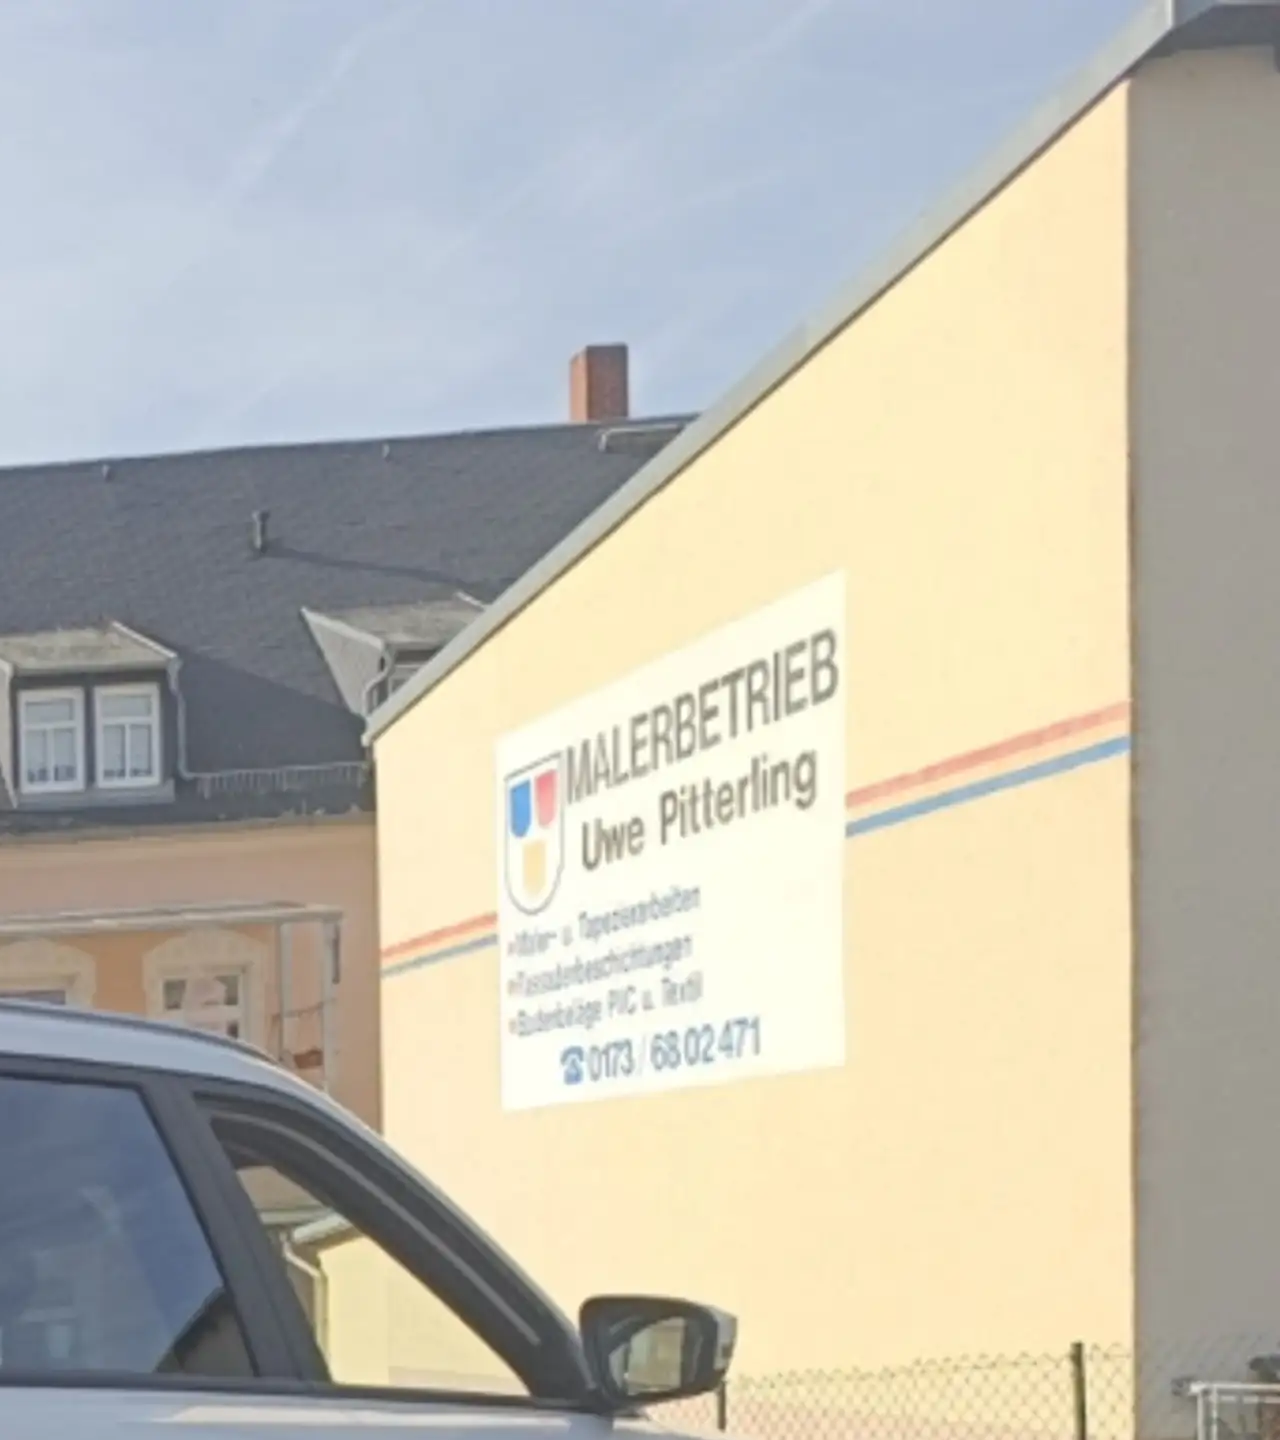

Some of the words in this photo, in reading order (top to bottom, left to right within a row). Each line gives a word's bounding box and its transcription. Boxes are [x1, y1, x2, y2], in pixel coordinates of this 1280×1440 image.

[566, 627, 839, 805] MALERBETRIEB
[581, 816, 645, 872] Uwe
[659, 748, 817, 845] Pitterling
